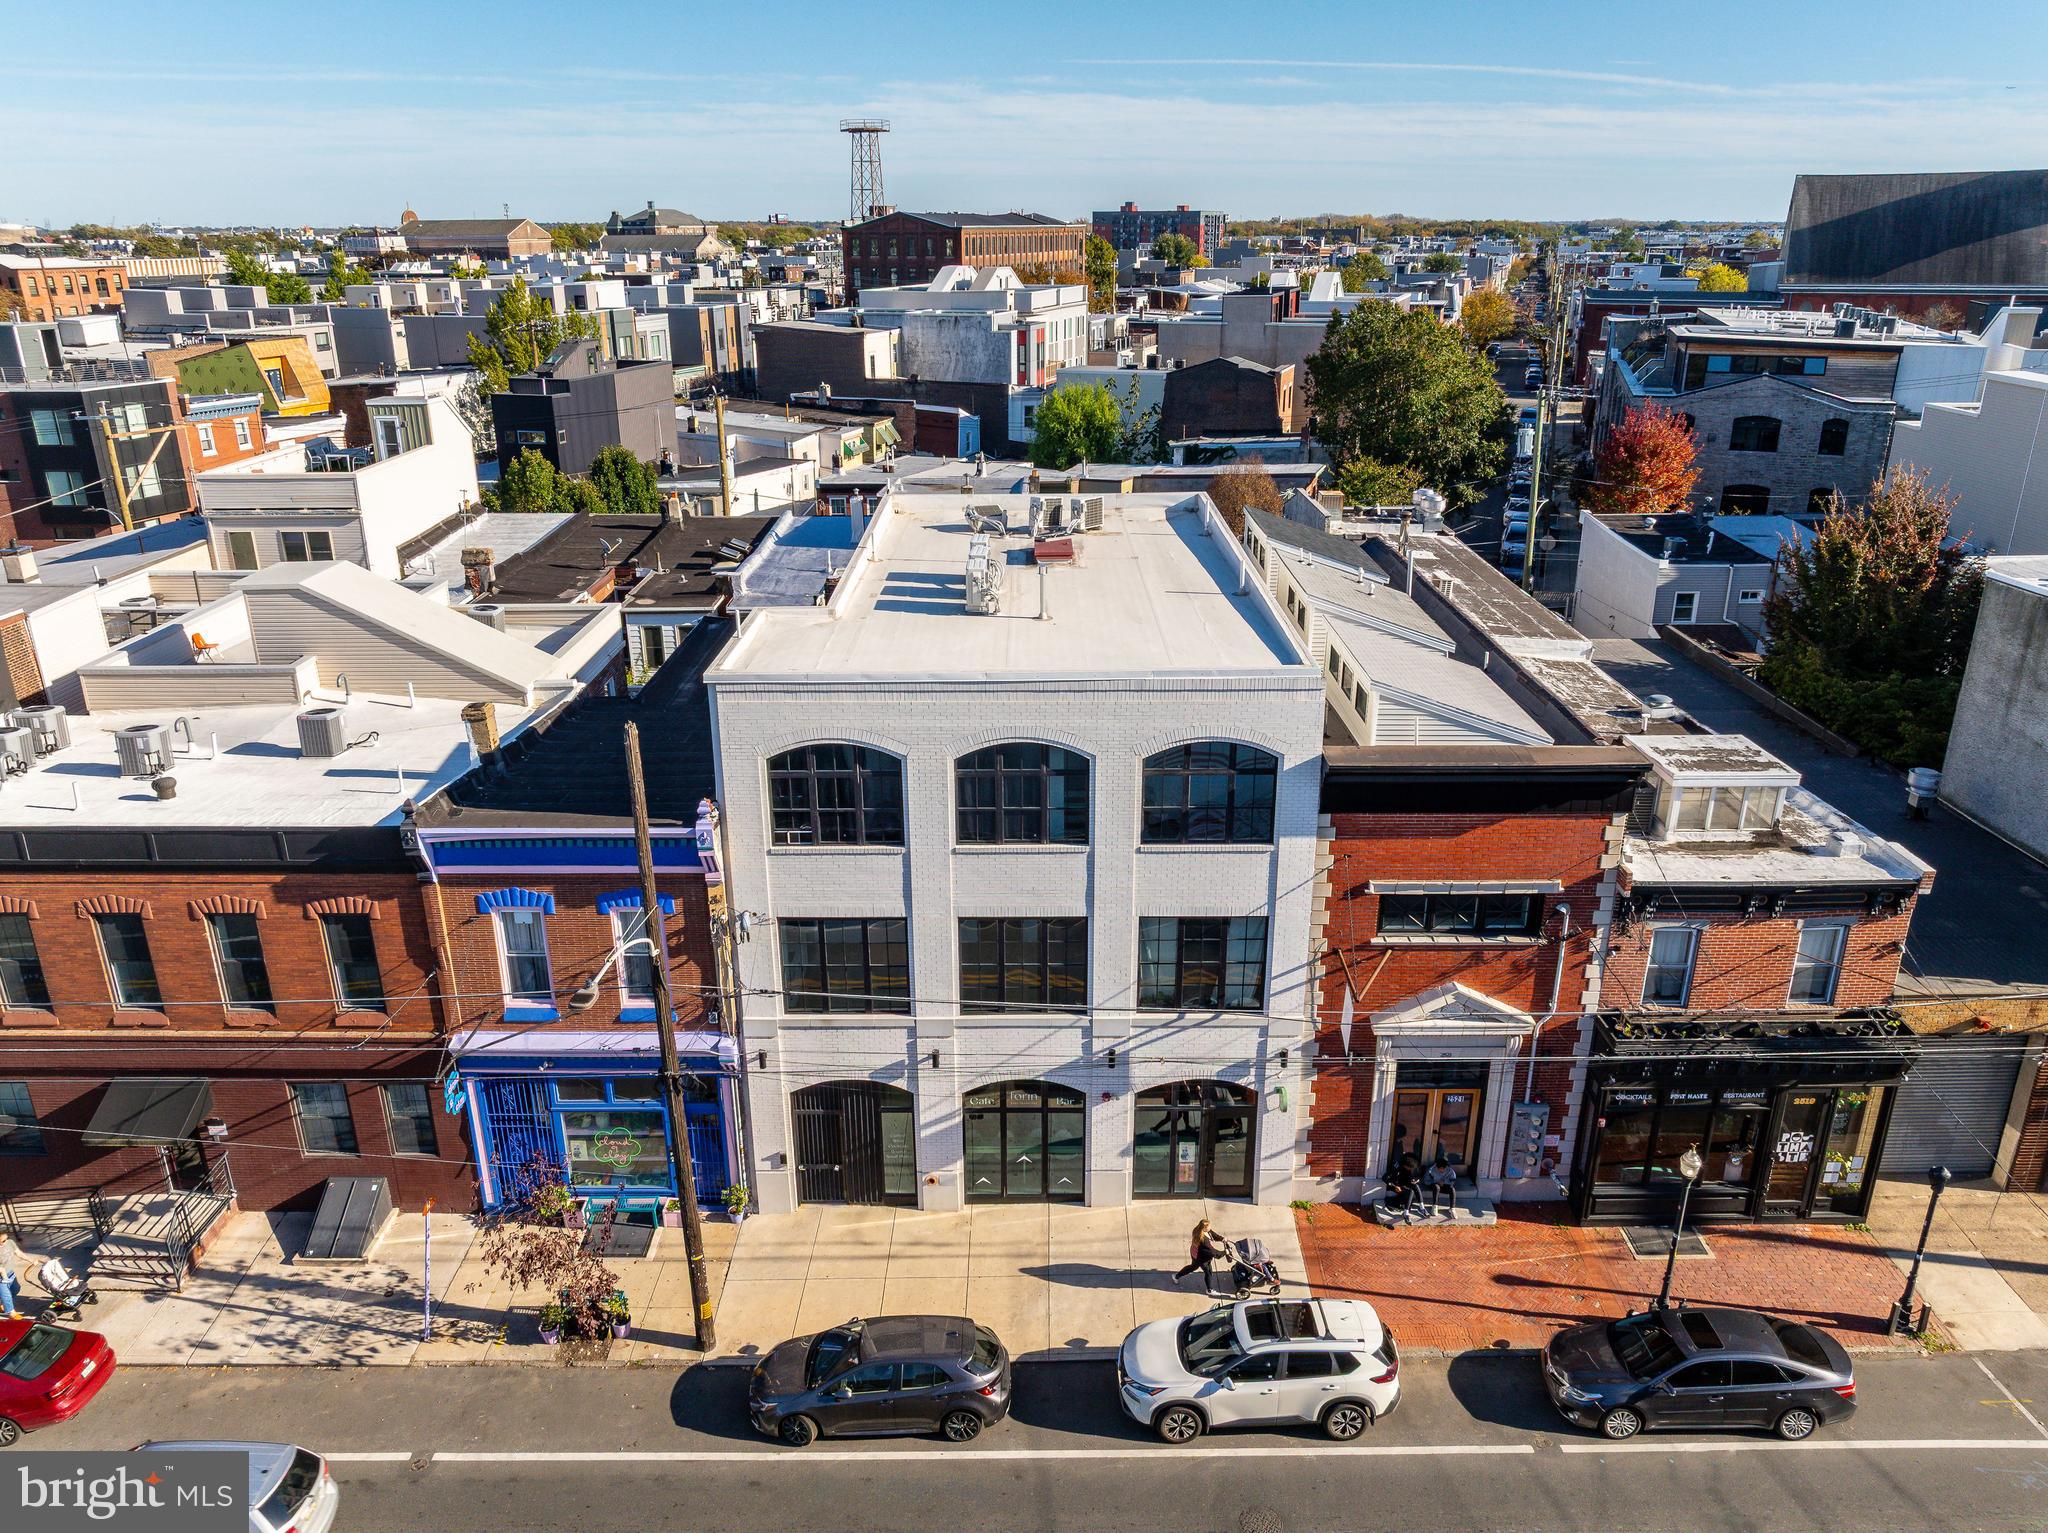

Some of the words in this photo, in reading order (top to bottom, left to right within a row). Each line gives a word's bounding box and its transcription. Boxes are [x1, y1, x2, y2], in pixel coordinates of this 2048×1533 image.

[1056, 1097, 1074, 1105] Bar
[600, 1136, 632, 1145] cloud
[603, 1150, 629, 1164] clay
